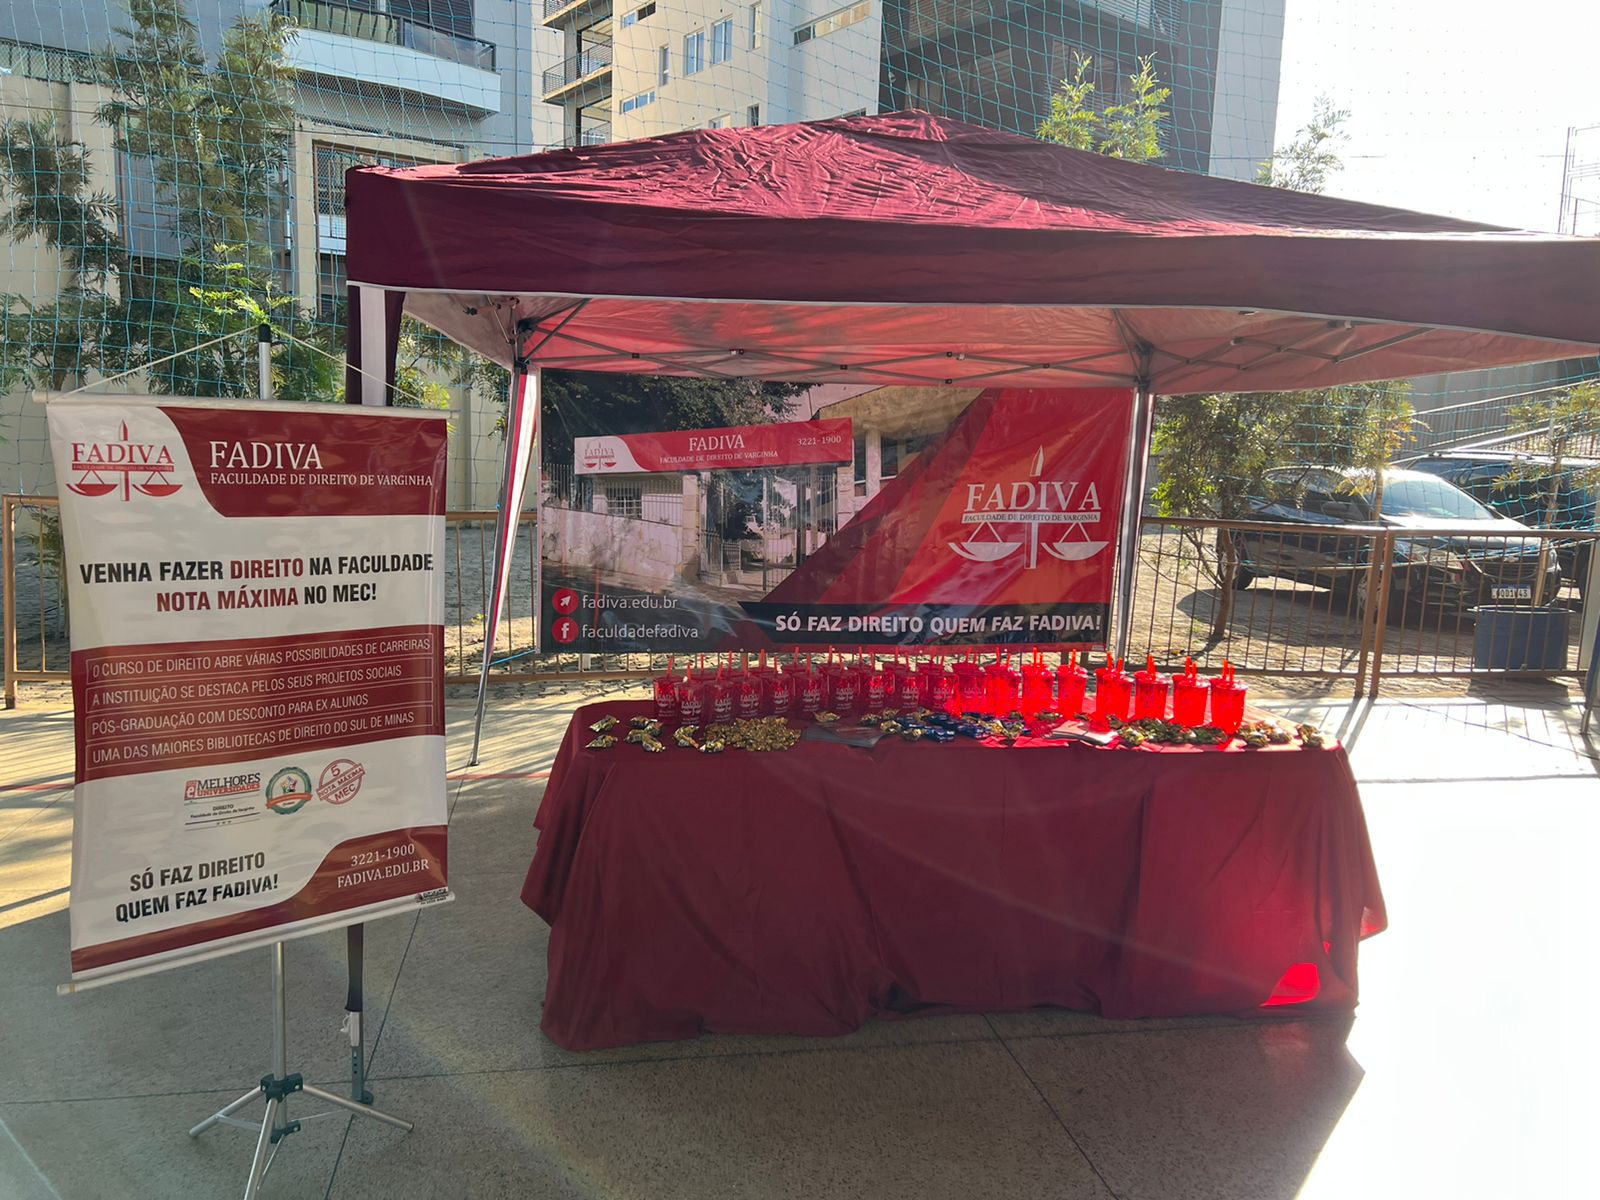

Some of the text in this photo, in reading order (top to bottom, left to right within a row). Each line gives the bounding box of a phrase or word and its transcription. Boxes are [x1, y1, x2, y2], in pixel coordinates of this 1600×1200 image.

[688, 434, 746, 452] FADIVA
[797, 435, 842, 446] 3221-1900
[71, 442, 174, 464] FADIVA
[209, 441, 324, 470] FADIVA
[210, 472, 433, 487] FACULDADE DE DIREITO DE VARGINHA
[964, 481, 1102, 512] FADIVA
[964, 513, 1006, 521] FACULDADE
[1063, 513, 1098, 521] VARGINHA
[79, 554, 434, 584] VENHA FAZER DIREITO NA FACULDADE
[157, 583, 377, 612] NOTA MÁXIMA NO MEC!
[582, 595, 678, 609] fadiva.edu.br
[582, 624, 699, 638] faculdadefadiva
[775, 611, 1102, 636] SÓ FAZ DIREITO QUEM FAZ FADIVA!
[92, 638, 431, 678] O CURSO DE DIREITO ABRE VÁRIAS POSSIBILIDADES DE CARREIRAS
[92, 664, 402, 707] A INSTITUIÇÃO SE DESTACA PELOS SEUS PROJETOS SOCIAIS
[92, 693, 369, 735] PÓS-GRADUAÇÃO COM DESCONTO PARA EX ALUNOS
[92, 712, 415, 763] UMA DAS MAIORES BIBLIOTECAS DE DIREITO DO SUL DE MINAS
[197, 772, 261, 791] MELHORES
[331, 765, 340, 777] 5
[197, 783, 261, 796] UNIVERSIDADES
[335, 784, 356, 800] MEC
[351, 843, 415, 867] 3221-1900
[130, 851, 265, 891] SÓ FAZ DIREITO
[337, 859, 429, 888] FADIVA.EDU.BR
[116, 874, 278, 923] QUEM FAZ FADIVA!
